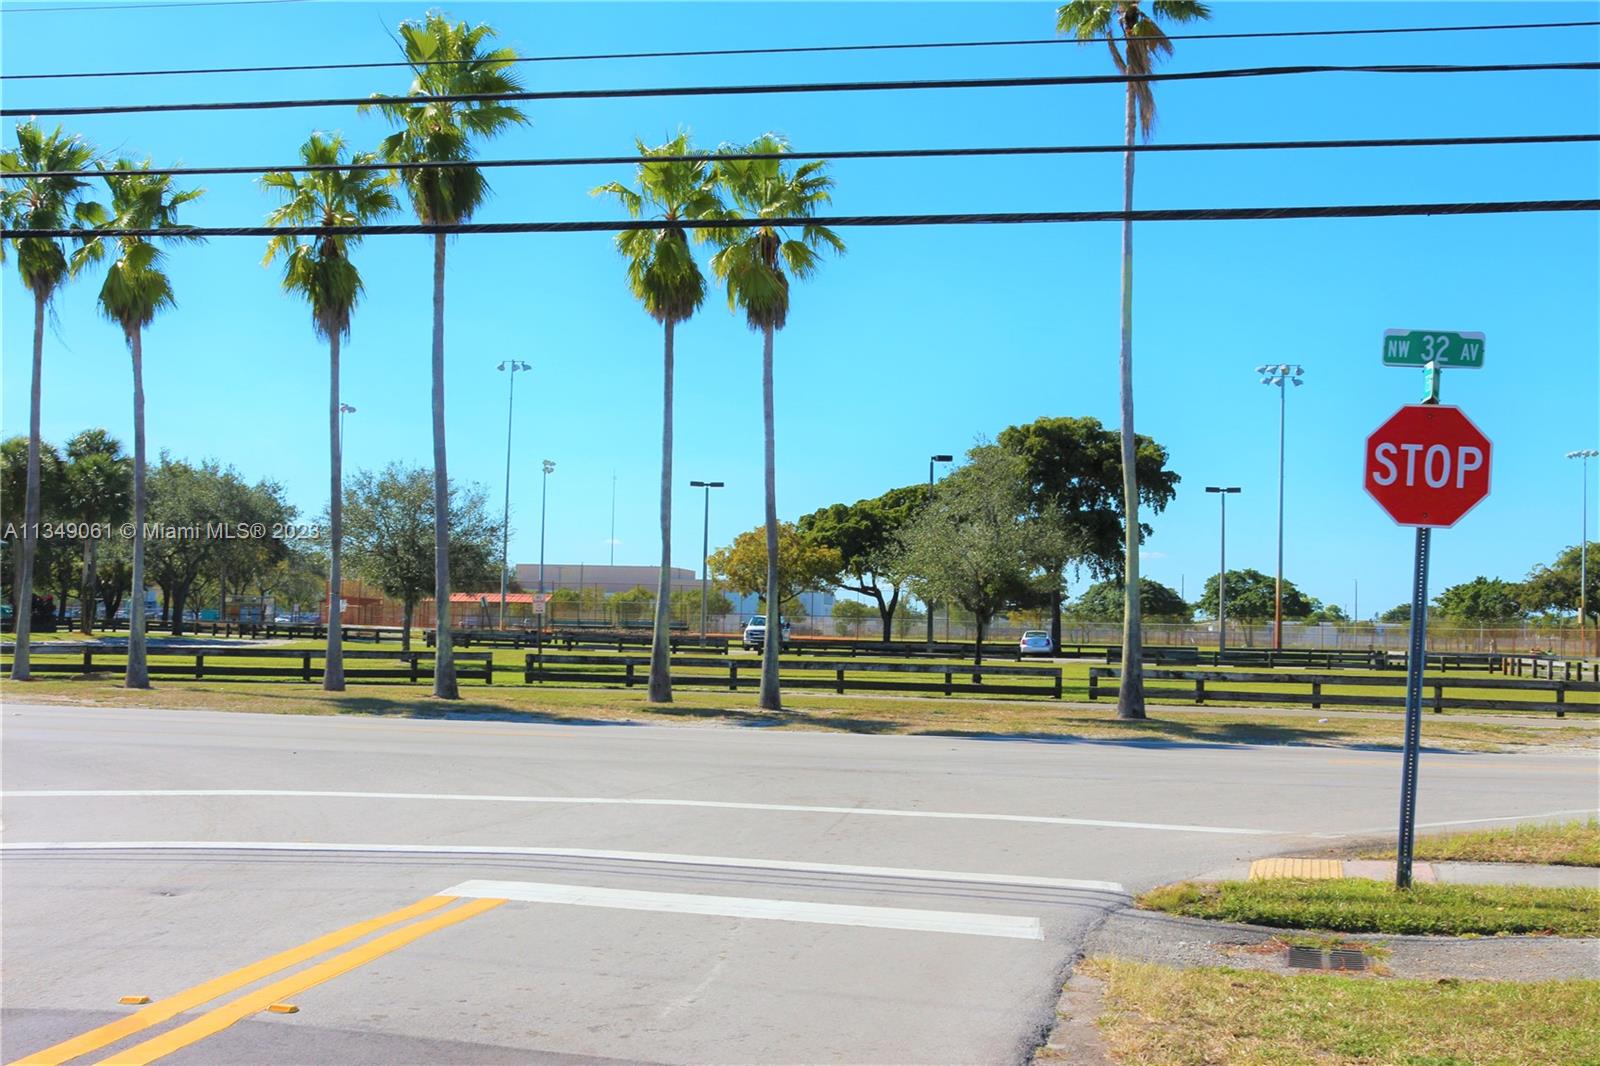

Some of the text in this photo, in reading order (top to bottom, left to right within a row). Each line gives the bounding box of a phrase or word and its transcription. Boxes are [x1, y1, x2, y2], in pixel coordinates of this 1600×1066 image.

[1388, 335, 1479, 362] NW 32 AV
[1372, 442, 1483, 489] STOP
